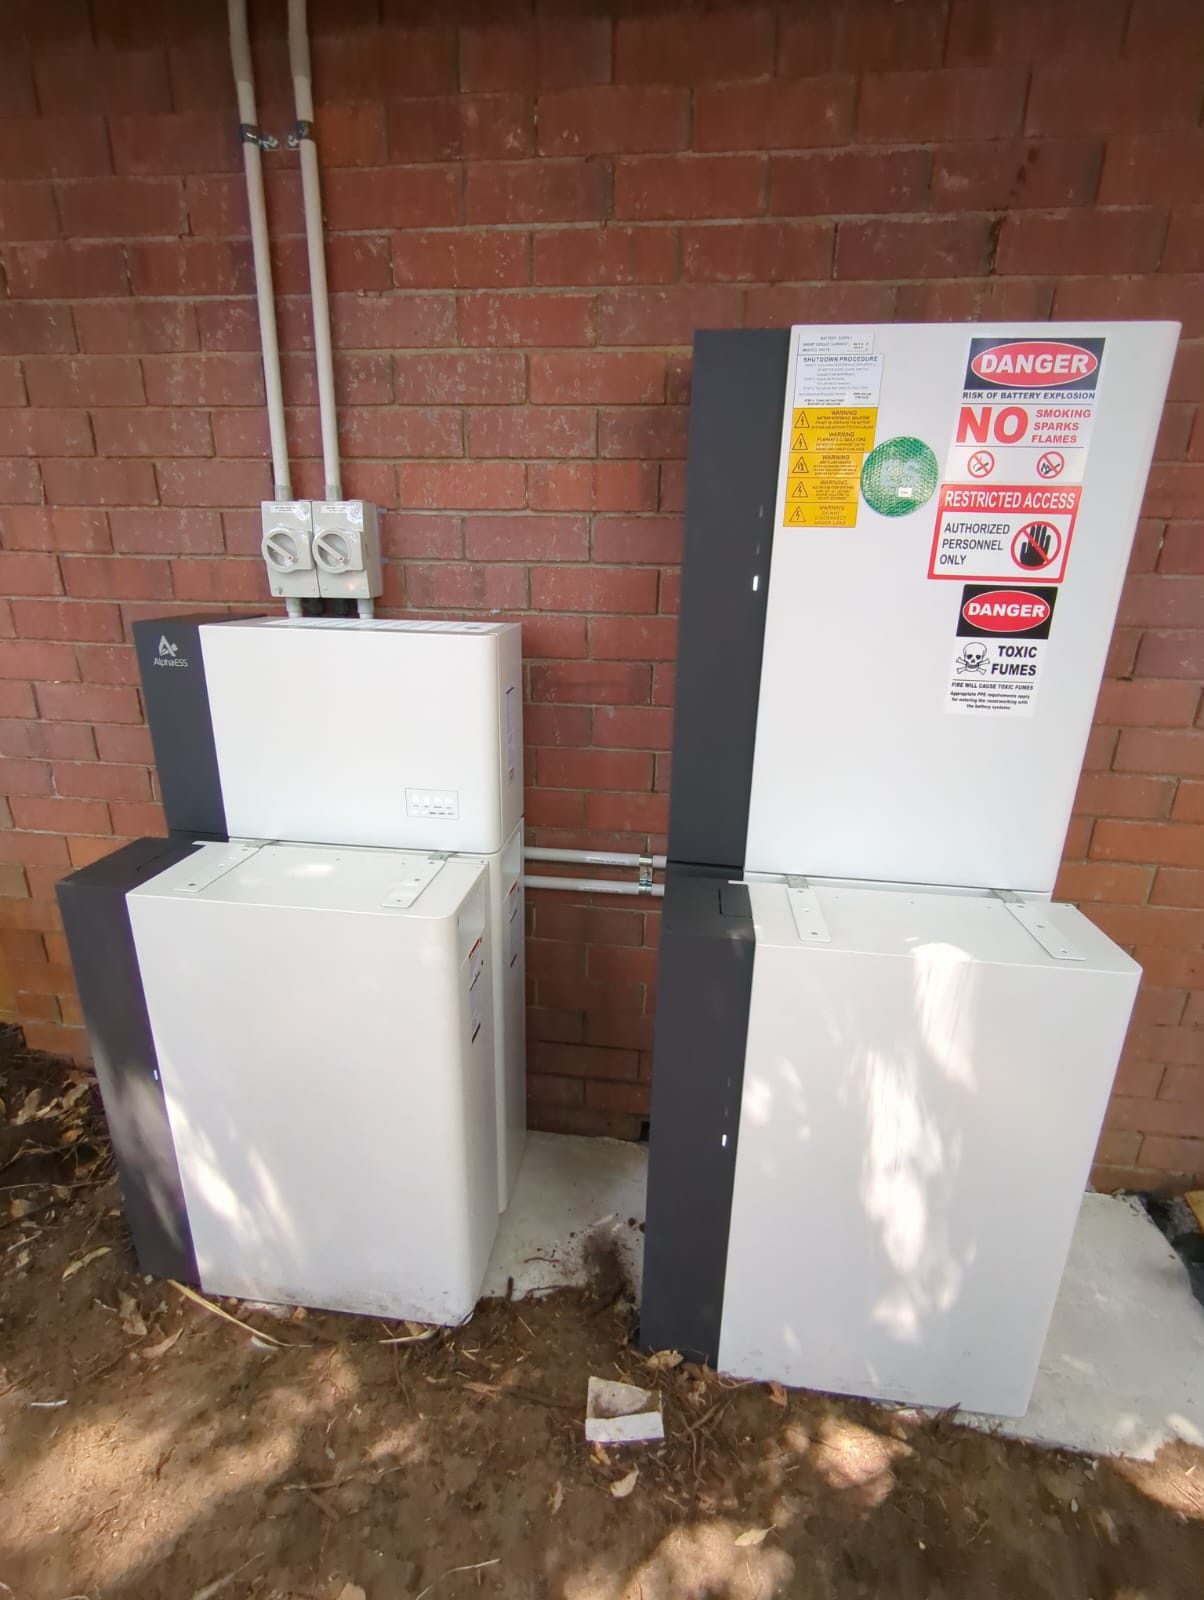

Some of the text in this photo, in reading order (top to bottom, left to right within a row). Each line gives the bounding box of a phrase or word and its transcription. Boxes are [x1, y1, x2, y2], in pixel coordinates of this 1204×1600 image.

[980, 354, 1089, 374] DANGER
[1043, 392, 1095, 400] EXPLOSION
[1036, 409, 1091, 418] SMOKING
[956, 406, 1029, 444] NO
[1033, 422, 1079, 431] SPARKS
[1031, 434, 1077, 444] FLAMES
[944, 491, 1075, 510] RESTRICTED ACCESS
[944, 523, 1010, 535] AUTHORIZED
[942, 539, 1003, 550] PERSONNEL
[939, 554, 967, 566] ONLY
[968, 602, 1045, 618] DANGER
[998, 646, 1037, 658] TOXIC
[153, 657, 188, 668] AlphaESS
[991, 664, 1037, 676] FUMES
